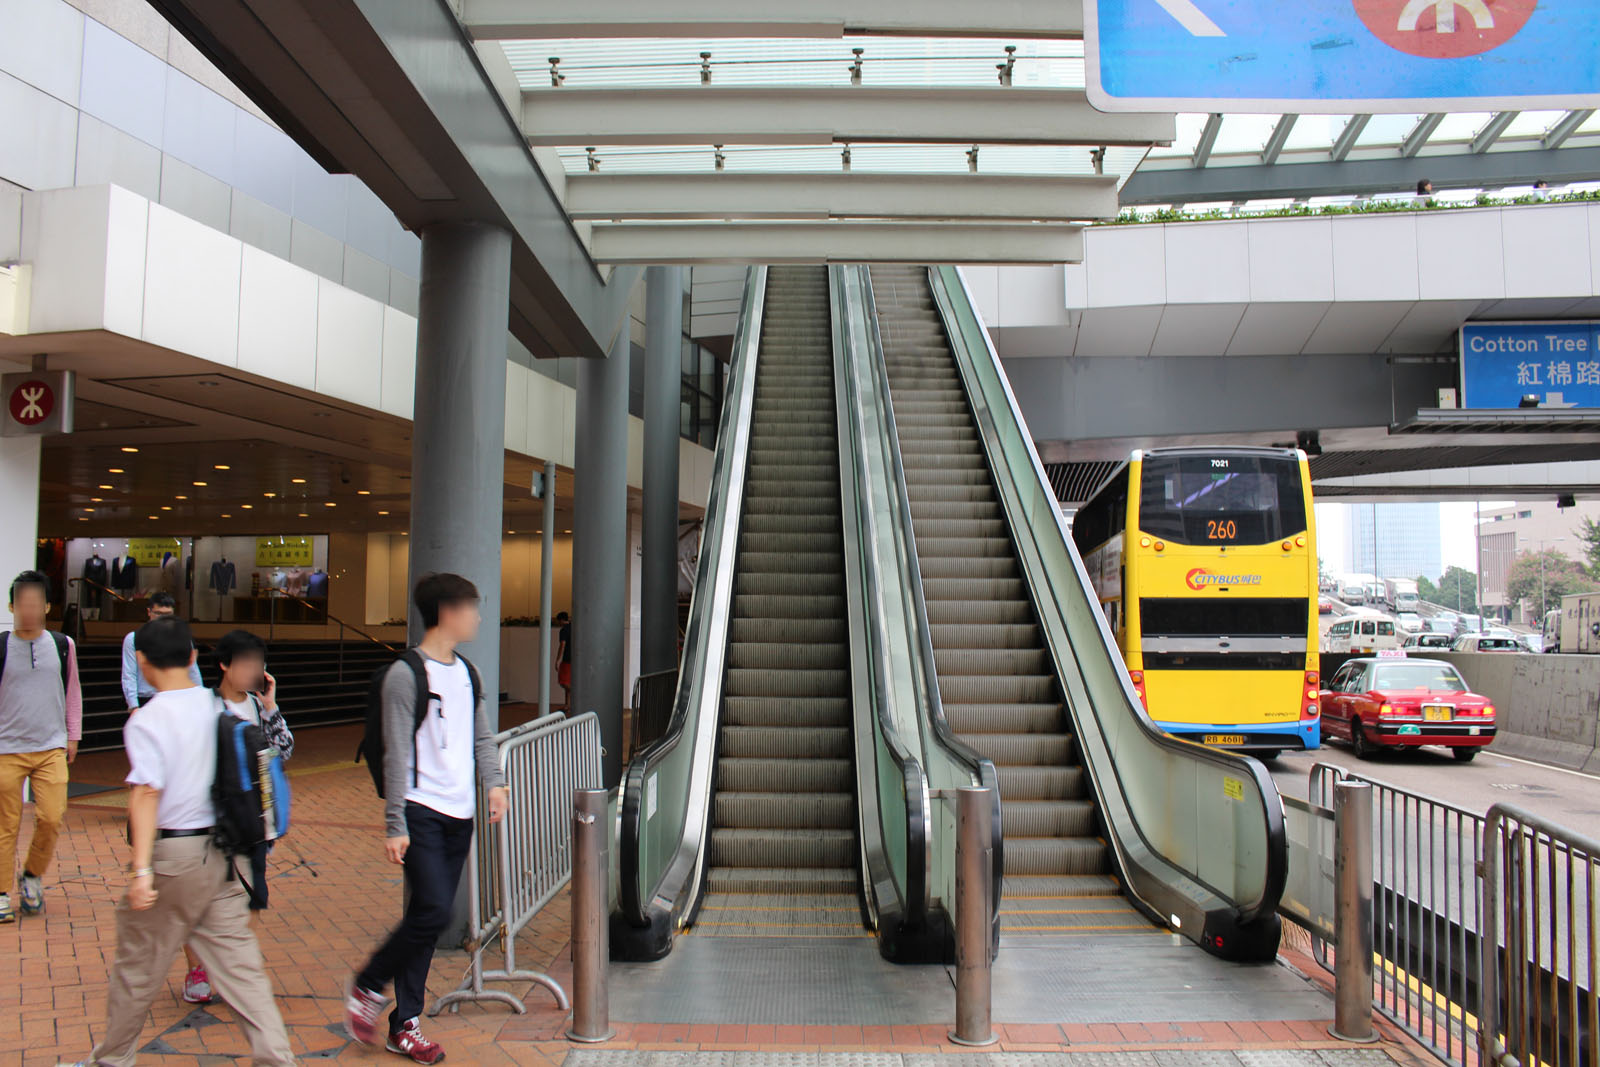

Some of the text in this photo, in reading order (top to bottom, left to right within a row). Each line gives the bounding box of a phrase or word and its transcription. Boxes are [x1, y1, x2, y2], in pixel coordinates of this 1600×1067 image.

[1470, 336, 1538, 352] Cotton
[1545, 335, 1587, 352] Tree
[1517, 360, 1600, 386] 紅棉路
[1208, 520, 1236, 539] 260
[1195, 574, 1240, 584] CITYBUS
